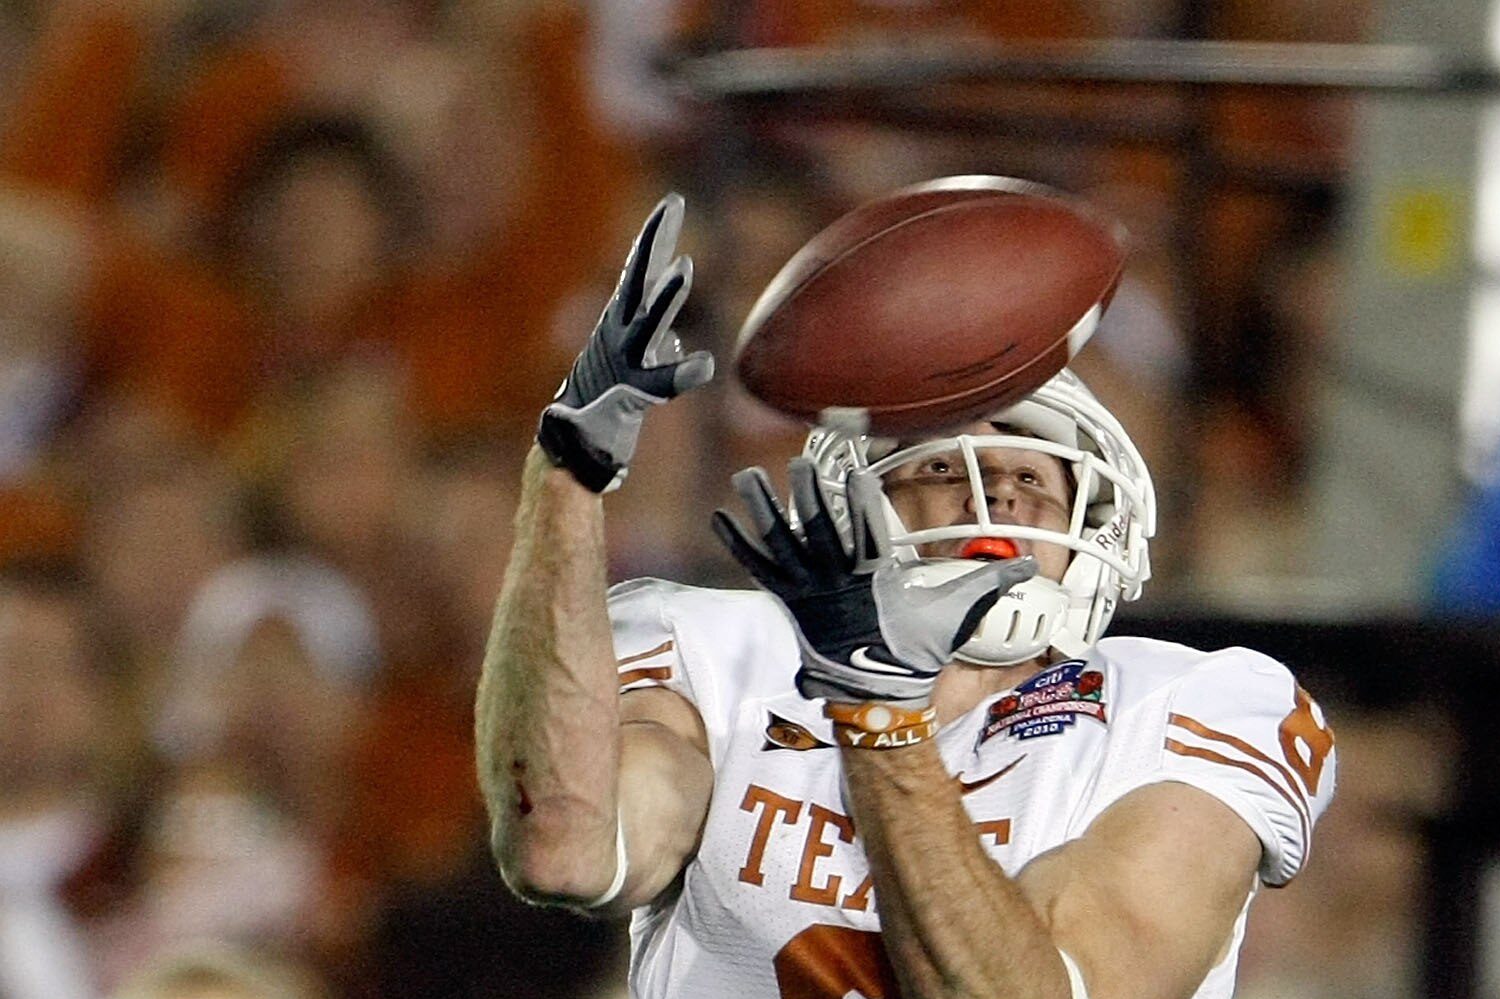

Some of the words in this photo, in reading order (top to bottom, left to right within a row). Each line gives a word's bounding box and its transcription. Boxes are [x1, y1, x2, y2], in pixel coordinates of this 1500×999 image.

[1035, 672, 1063, 688] citi
[1022, 722, 1058, 736] 2010
[874, 730, 922, 747] ALL
